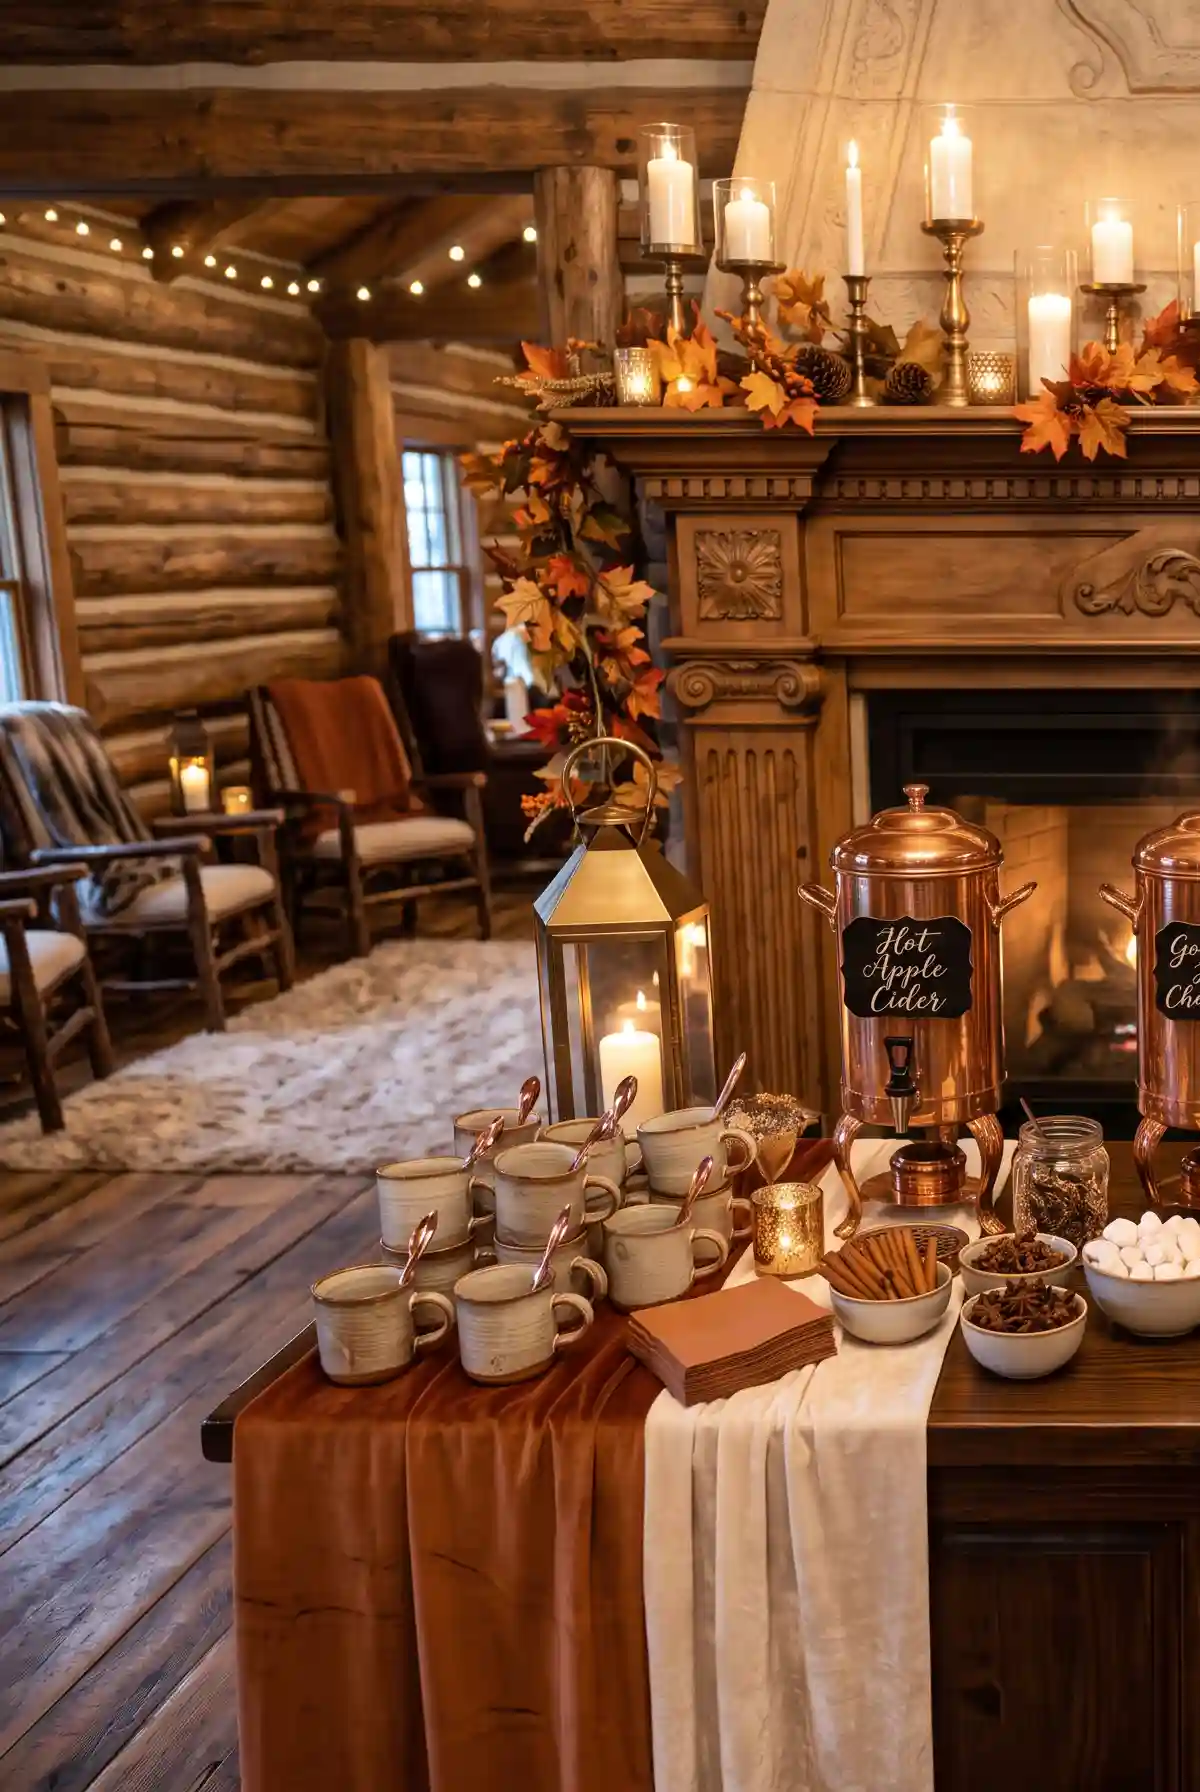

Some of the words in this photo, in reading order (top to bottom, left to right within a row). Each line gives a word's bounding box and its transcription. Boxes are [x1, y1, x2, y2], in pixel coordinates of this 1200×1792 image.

[876, 927, 942, 955] Hot
[863, 954, 948, 991] Apple
[870, 983, 947, 1013] Cider
